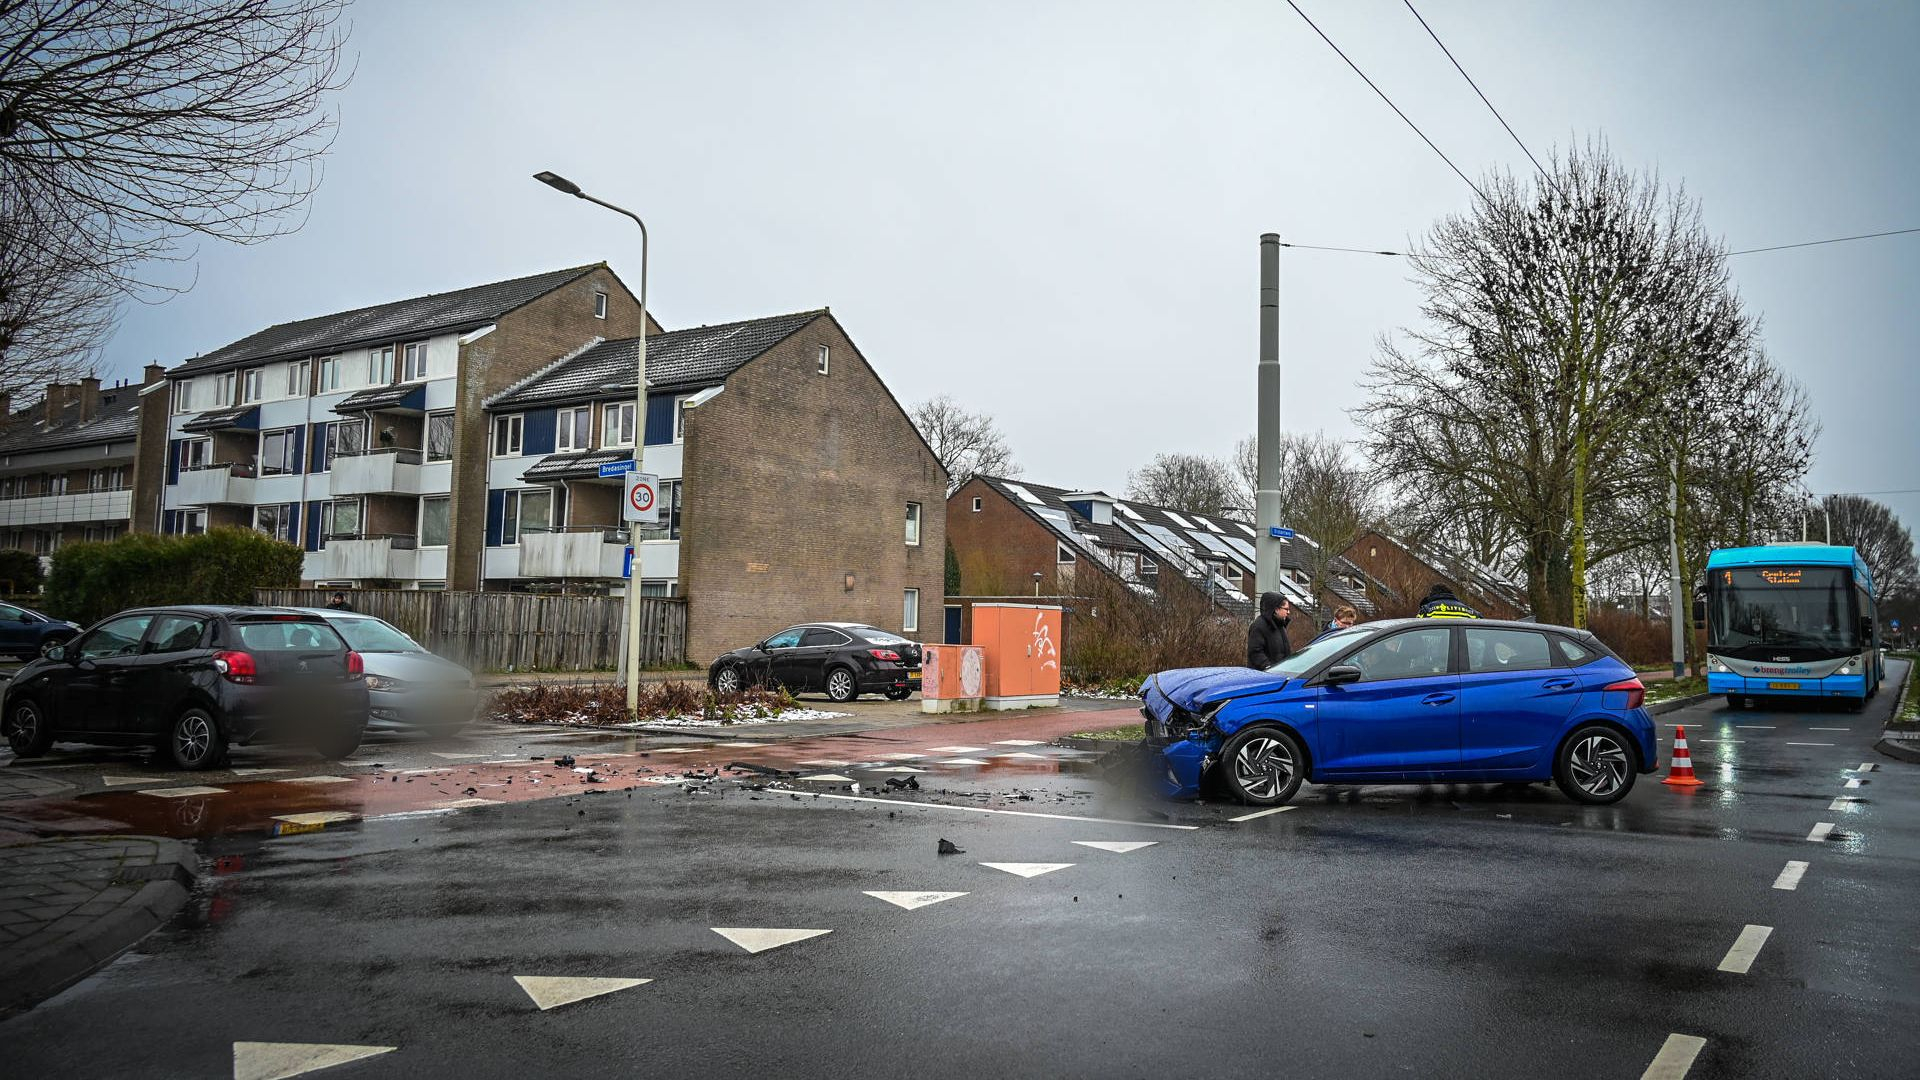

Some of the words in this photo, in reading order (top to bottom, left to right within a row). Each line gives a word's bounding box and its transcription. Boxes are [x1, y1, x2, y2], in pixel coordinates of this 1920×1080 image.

[602, 463, 632, 473] Bredasingel
[635, 492, 650, 503] 30
[1724, 571, 1732, 585] 1
